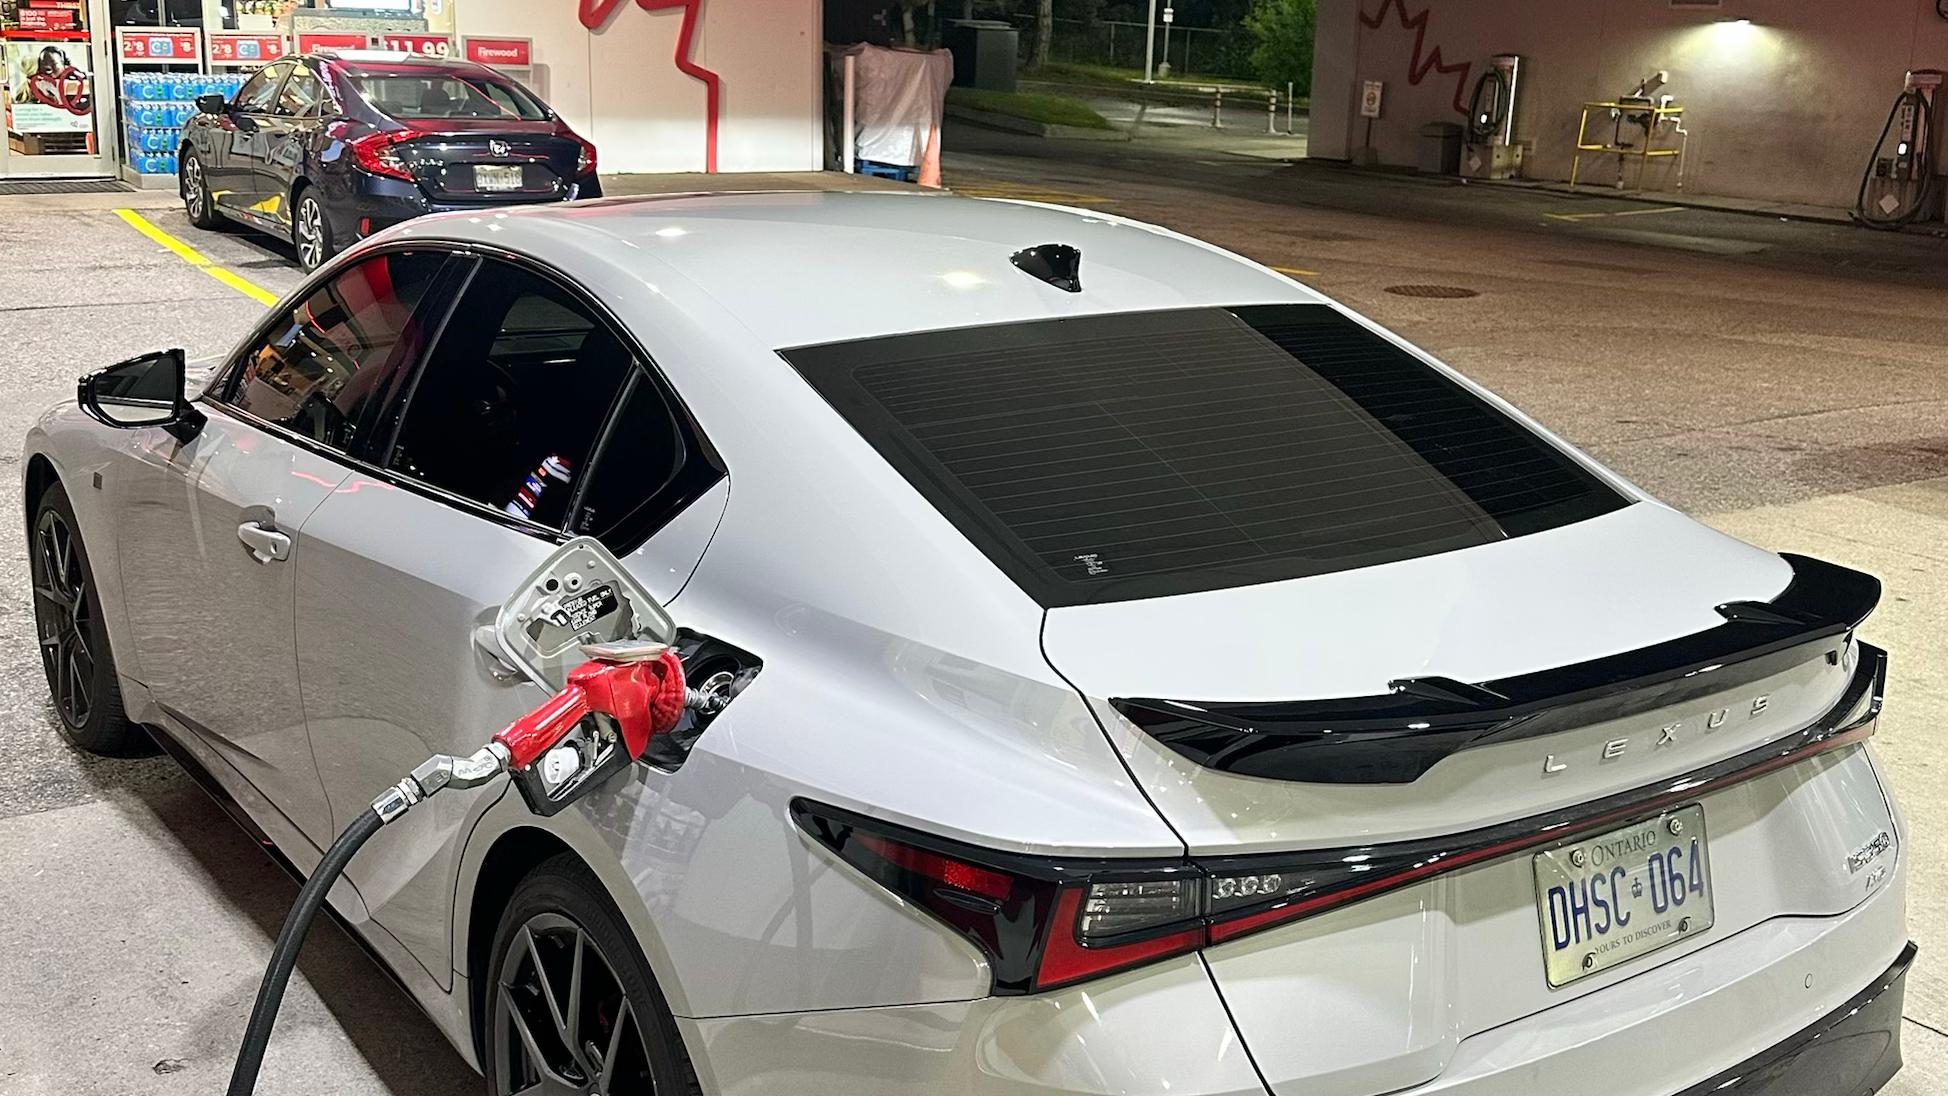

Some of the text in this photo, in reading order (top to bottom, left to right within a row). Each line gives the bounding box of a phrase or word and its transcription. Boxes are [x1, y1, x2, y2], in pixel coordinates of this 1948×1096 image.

[478, 47, 517, 57] Firewood
[1544, 694, 1770, 774] LEXUS
[1591, 831, 1656, 867] ONTARIO
[1548, 840, 1704, 951] DHSC 064
[1595, 919, 1671, 954] YOURS TO DISCOVER
